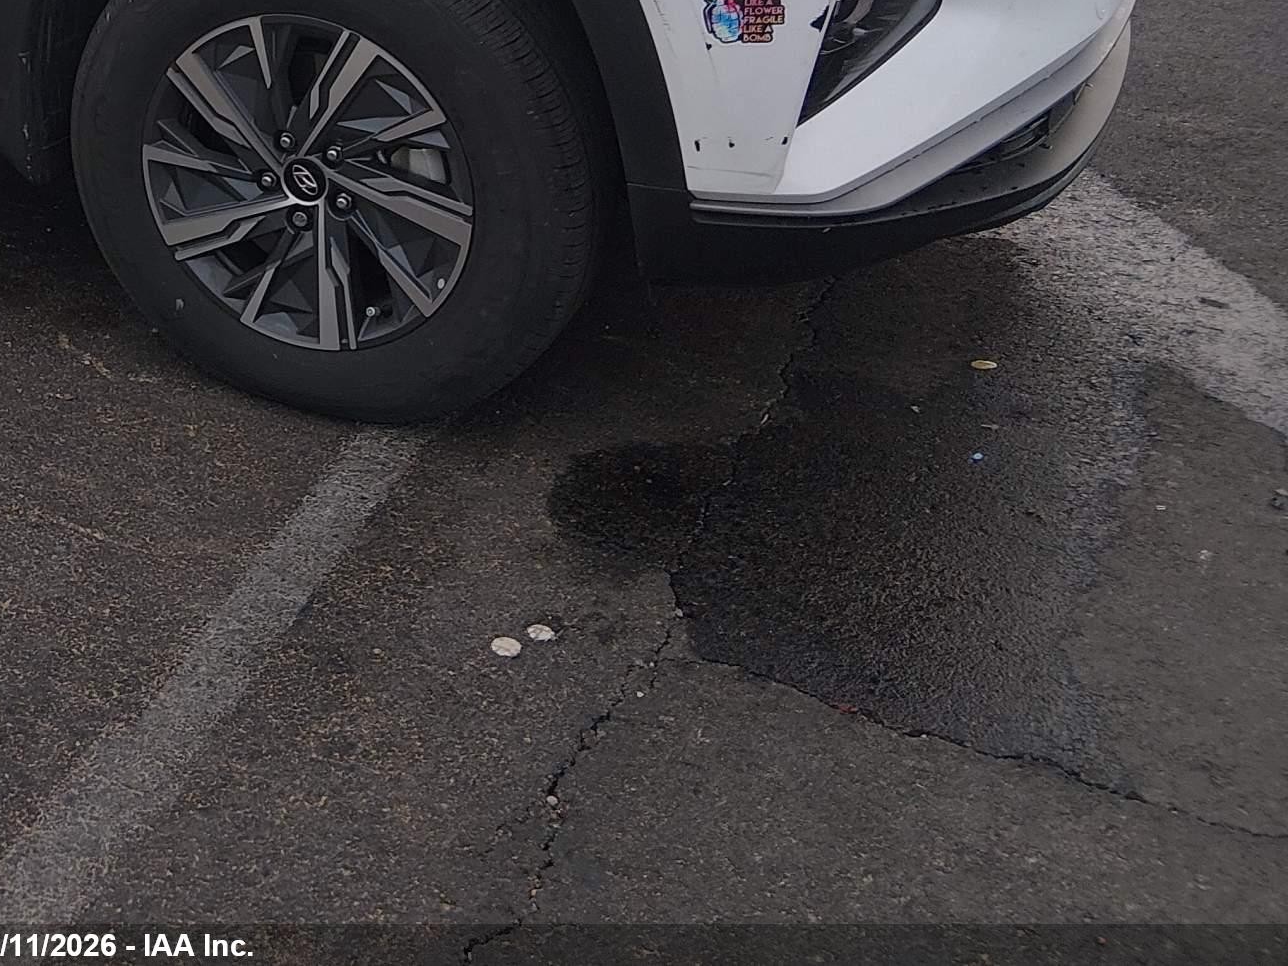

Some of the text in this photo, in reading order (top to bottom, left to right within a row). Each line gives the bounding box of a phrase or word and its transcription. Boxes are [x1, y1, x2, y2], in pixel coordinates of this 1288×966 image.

[744, 7, 784, 15] FLOWER
[743, 15, 784, 25] FRAGILE
[743, 24, 772, 33] LIKE A
[743, 34, 772, 42] BOMB
